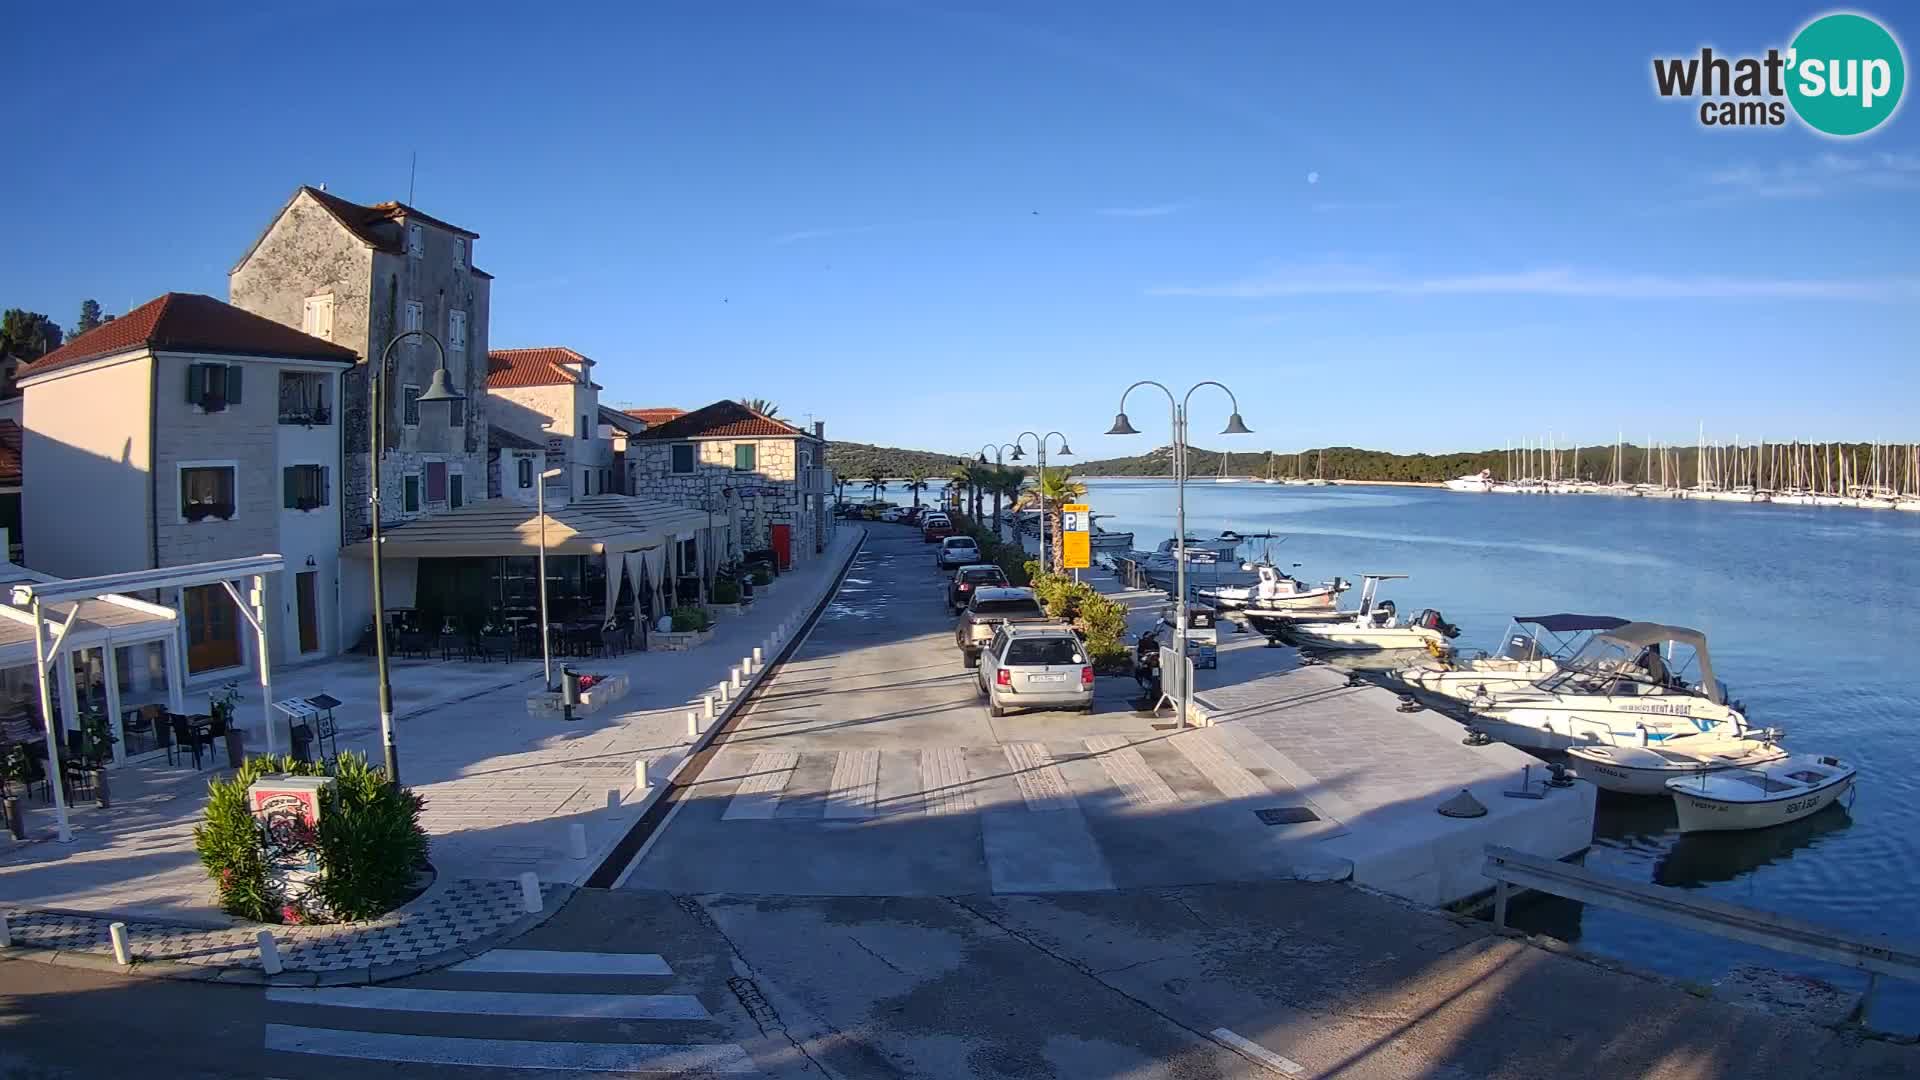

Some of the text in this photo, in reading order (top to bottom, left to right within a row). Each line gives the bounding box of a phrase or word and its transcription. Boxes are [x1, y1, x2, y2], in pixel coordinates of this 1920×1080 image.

[1065, 513, 1076, 530] P
[1651, 704, 1668, 713] RENT
[1675, 704, 1692, 715] BOAT
